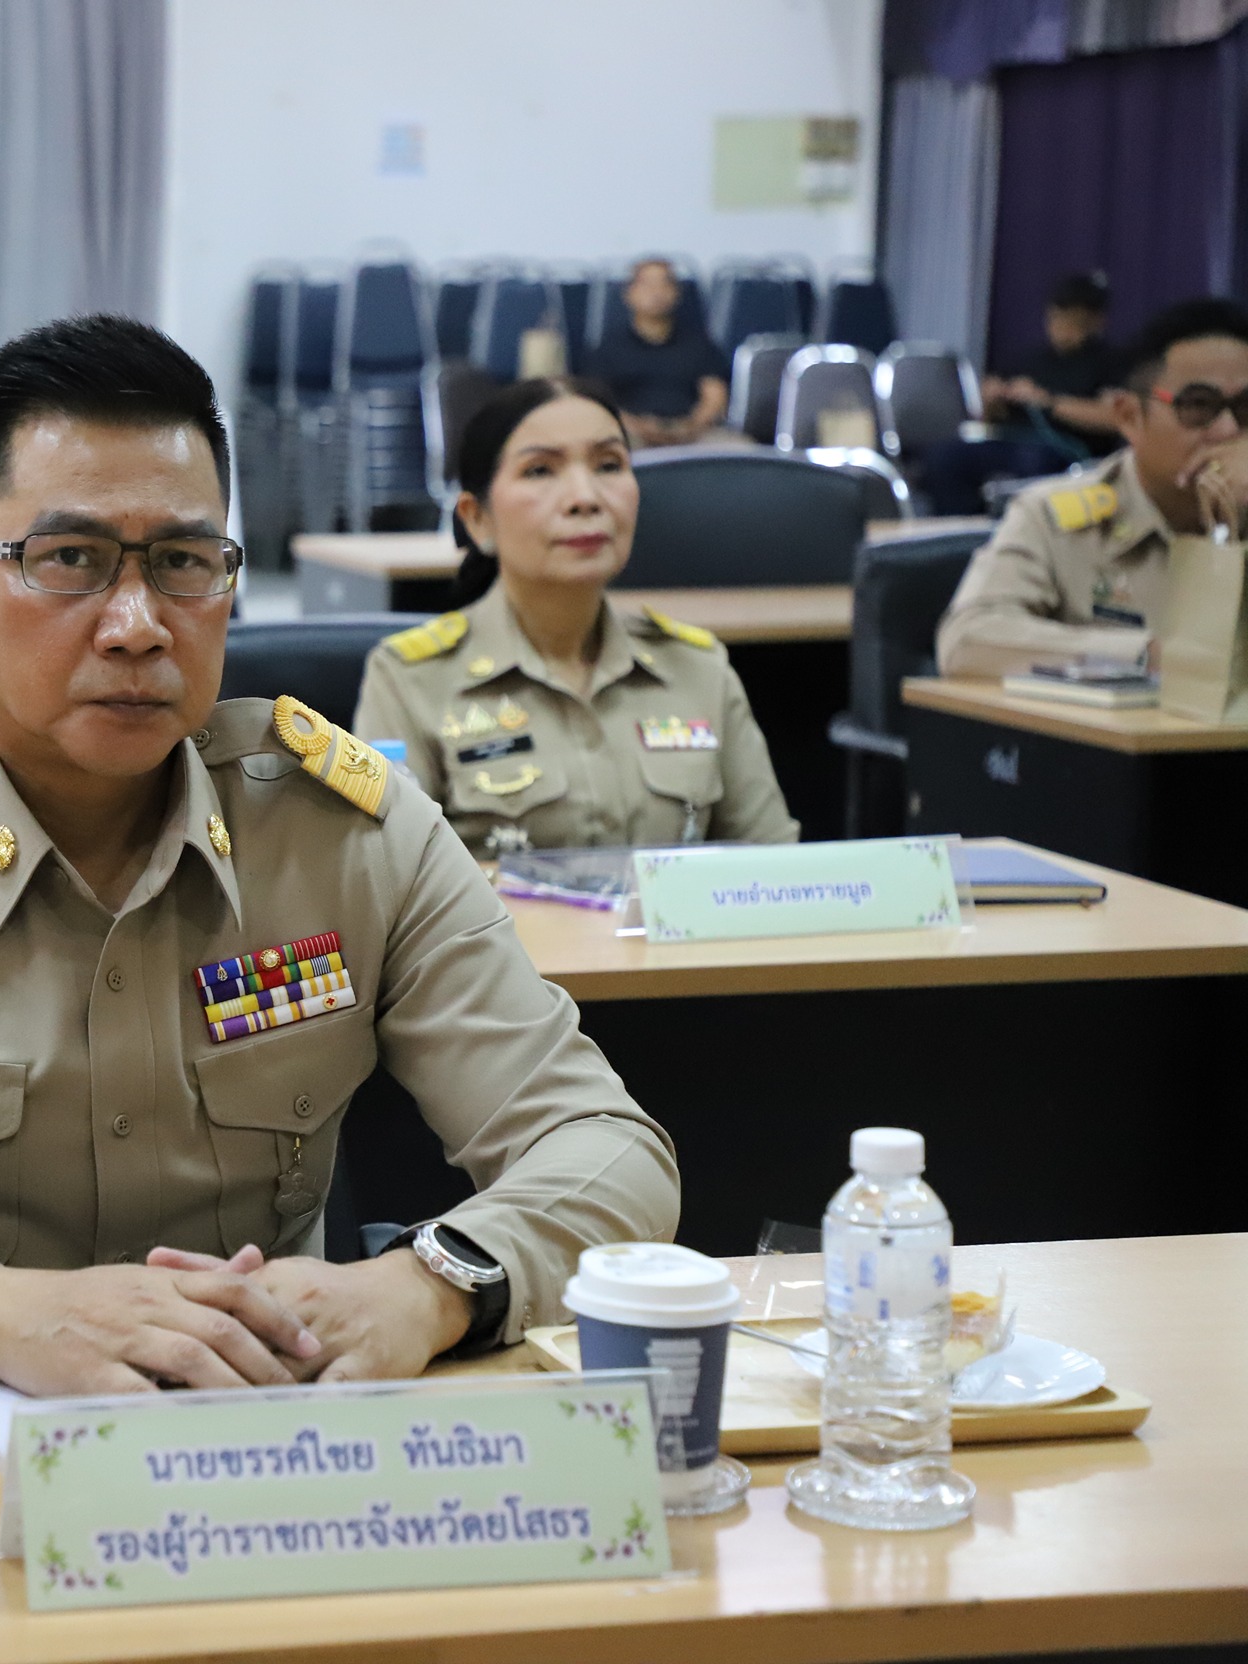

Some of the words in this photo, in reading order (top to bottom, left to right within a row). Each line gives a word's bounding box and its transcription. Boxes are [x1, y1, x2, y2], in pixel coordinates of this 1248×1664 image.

[712, 880, 872, 906] นายอำเภอทรายมูล
[147, 1428, 376, 1481] นายขรรค์ไชย
[402, 1424, 525, 1467] ทันธิมา
[96, 1497, 592, 1575] รองผู้ว่าราชการจังหวัดยโสธร
